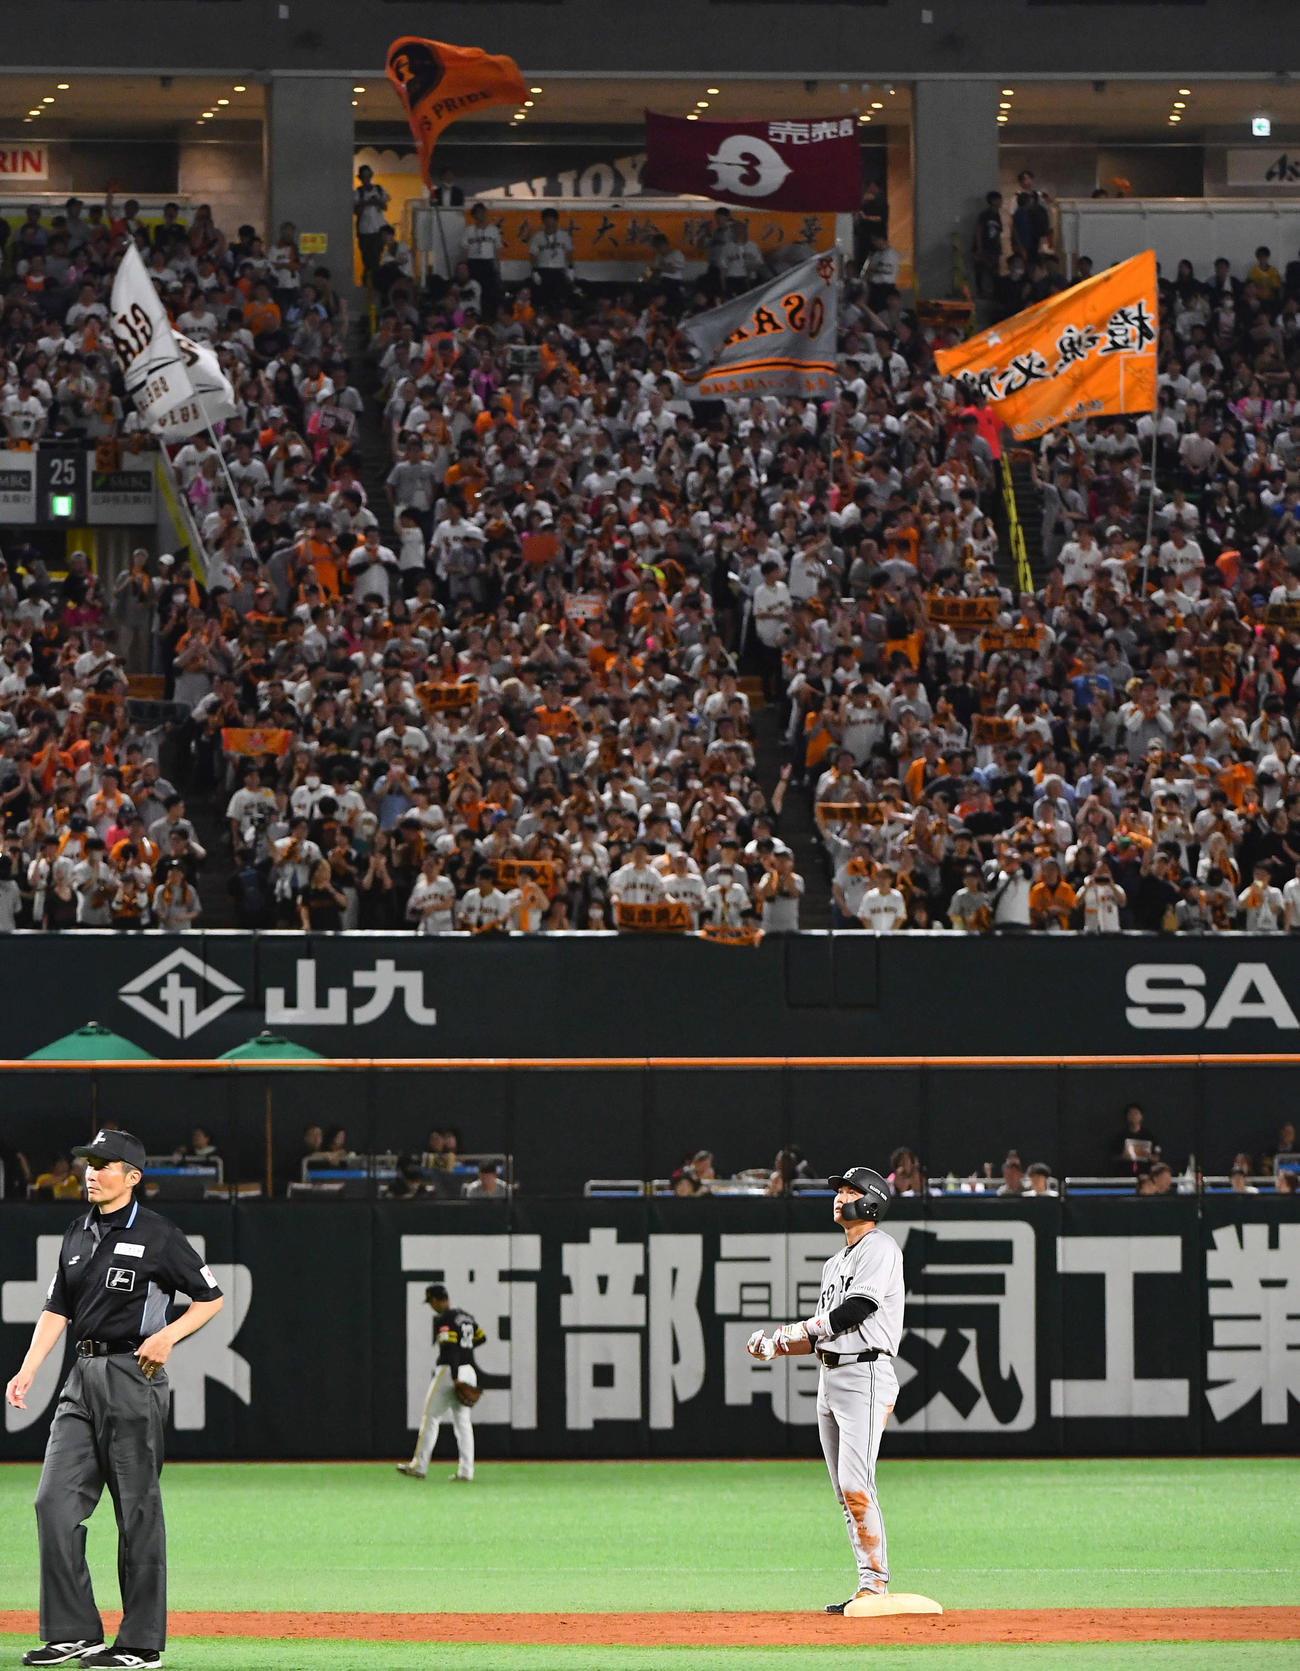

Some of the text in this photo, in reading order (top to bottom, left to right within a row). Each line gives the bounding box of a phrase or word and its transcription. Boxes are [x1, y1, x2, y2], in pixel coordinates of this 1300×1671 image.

[50, 458, 76, 485] 25
[265, 958, 437, 1026] 山九
[1125, 962, 1300, 1030] SA
[400, 1220, 1300, 1433] 西部電気工業
